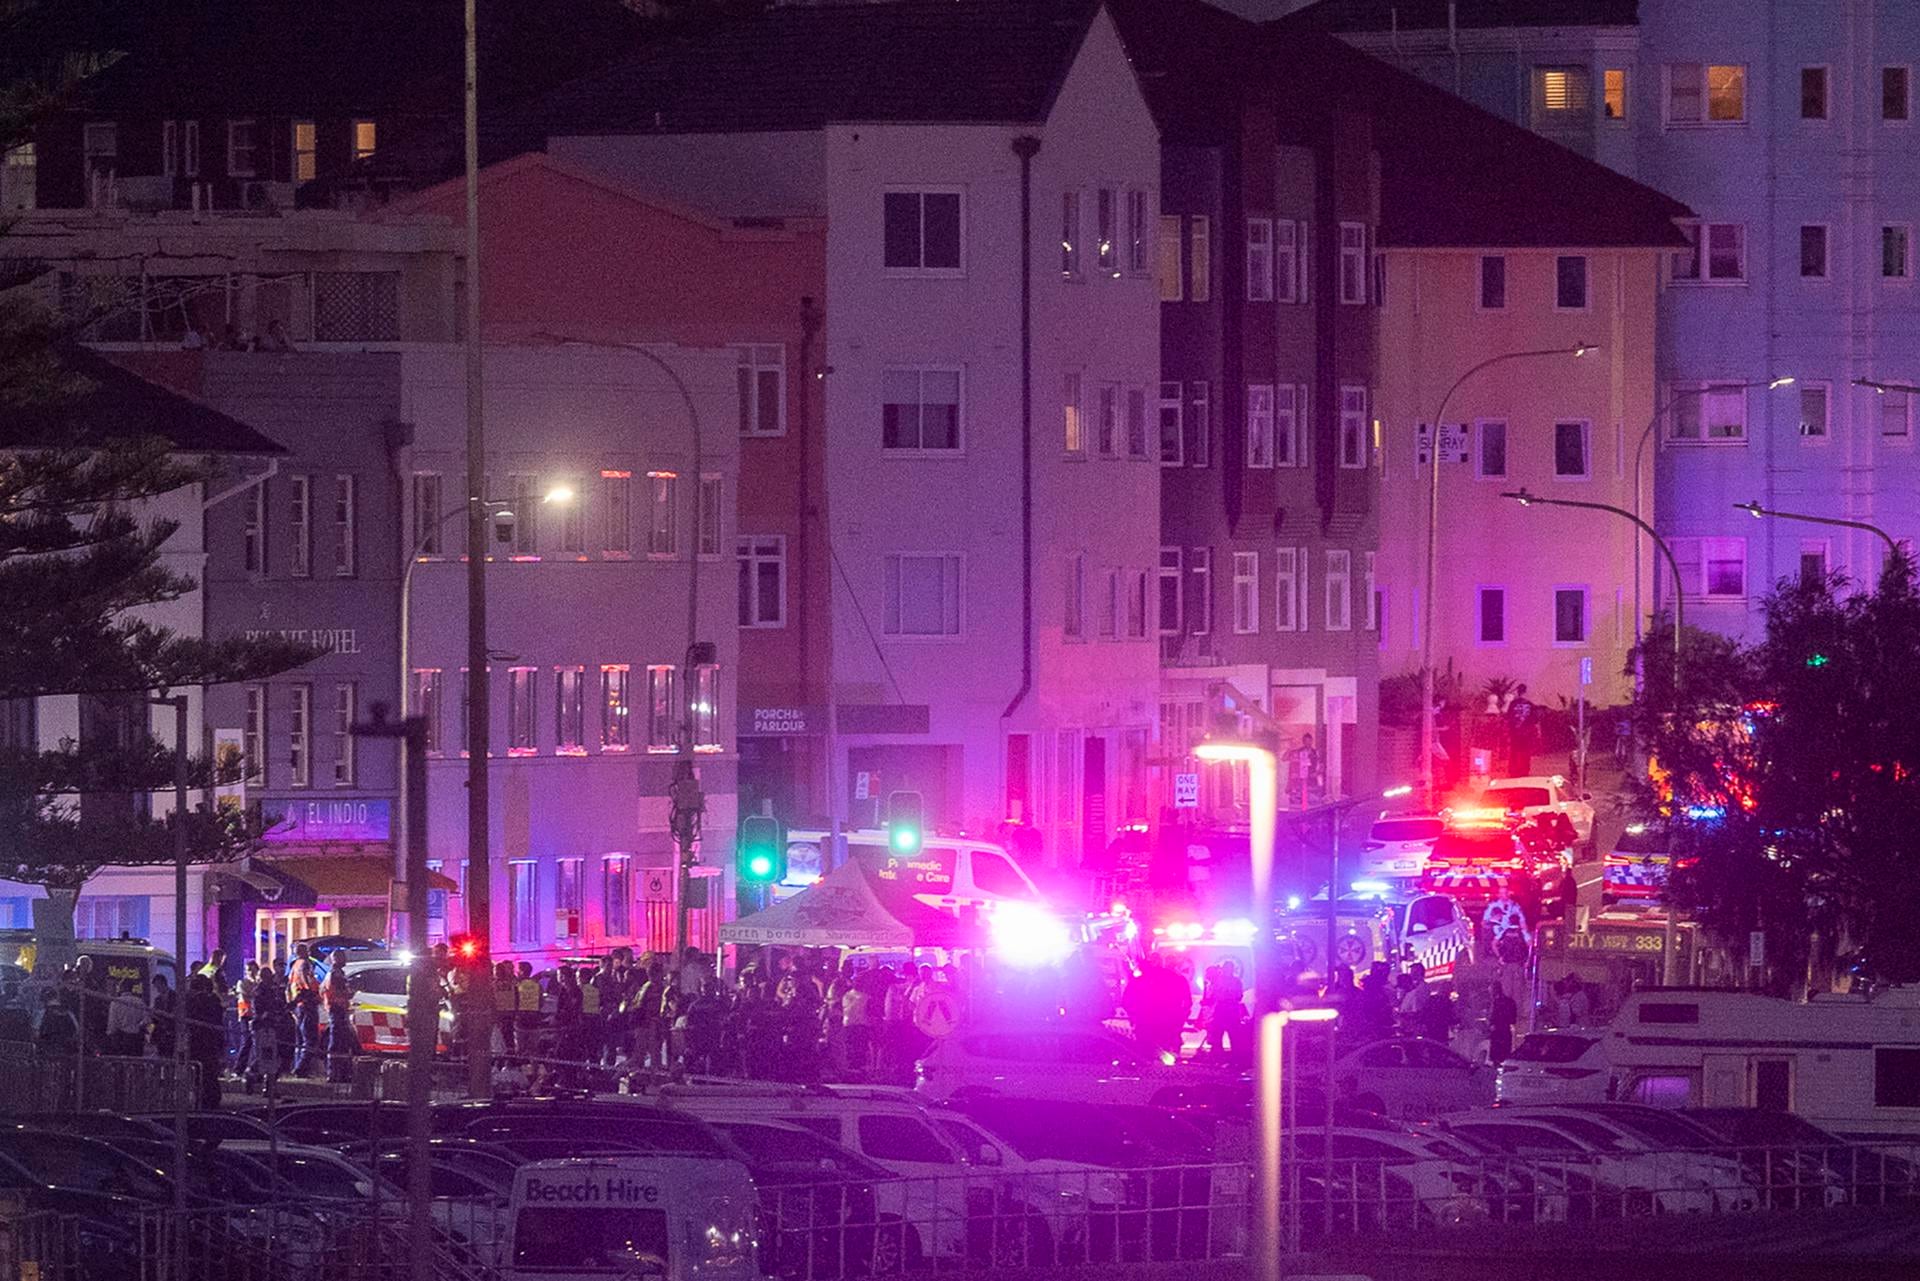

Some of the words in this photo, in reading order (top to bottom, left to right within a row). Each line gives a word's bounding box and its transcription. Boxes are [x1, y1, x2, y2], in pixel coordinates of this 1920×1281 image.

[754, 721, 806, 732] PARLOUR
[1178, 775, 1195, 785] ONE
[1177, 786, 1196, 794] WAY
[308, 802, 323, 824] EL
[328, 802, 367, 824] INDIO
[925, 871, 950, 883] Care
[720, 928, 759, 938] north
[1635, 935, 1663, 950] 333
[526, 1178, 600, 1202] Beach
[606, 1178, 658, 1202] Hire
